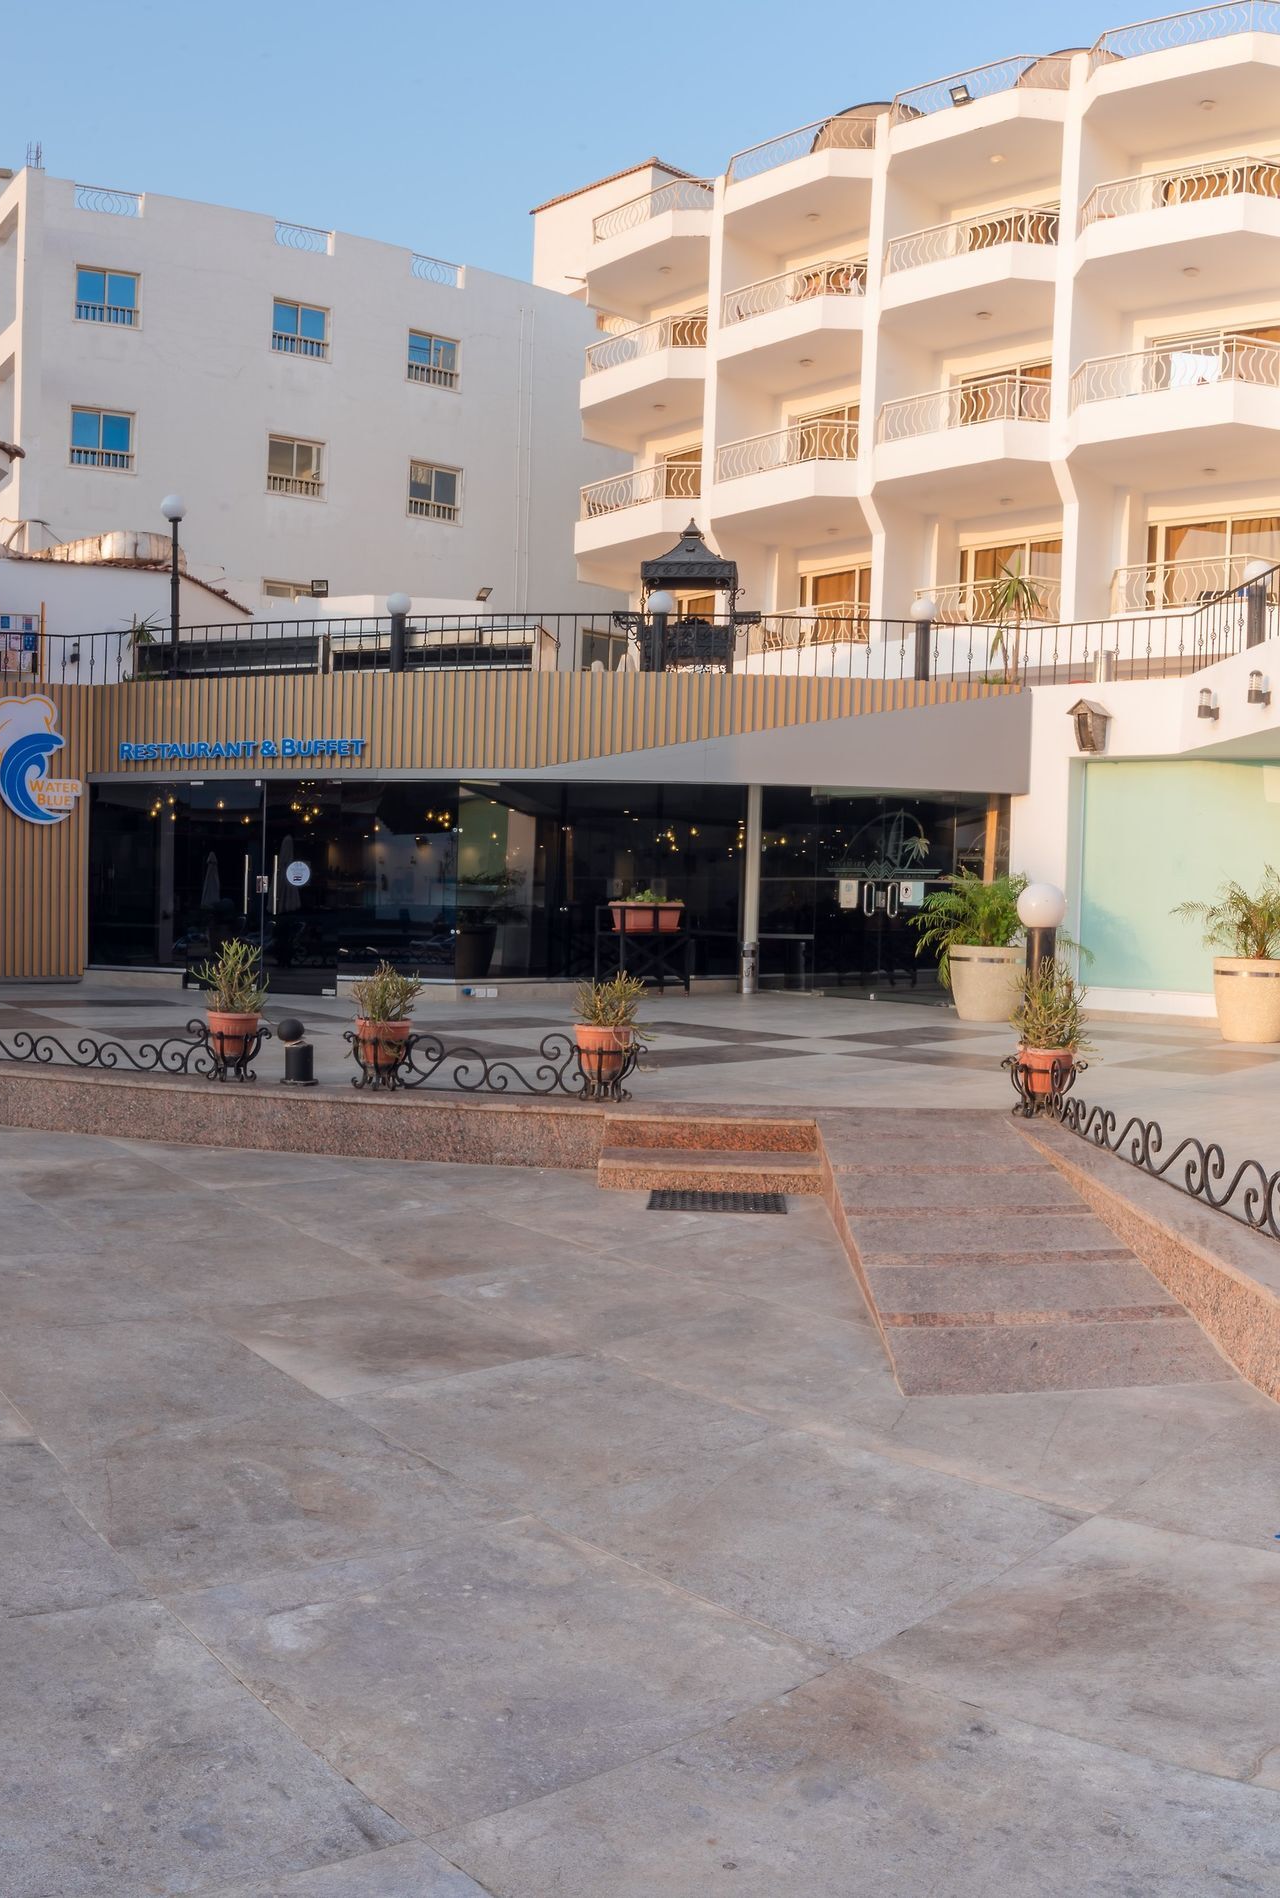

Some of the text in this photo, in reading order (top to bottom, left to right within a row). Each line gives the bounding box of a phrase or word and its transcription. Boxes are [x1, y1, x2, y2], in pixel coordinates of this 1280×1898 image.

[260, 739, 278, 758] &
[29, 780, 79, 793] WATER
[36, 793, 72, 806] BLUE
